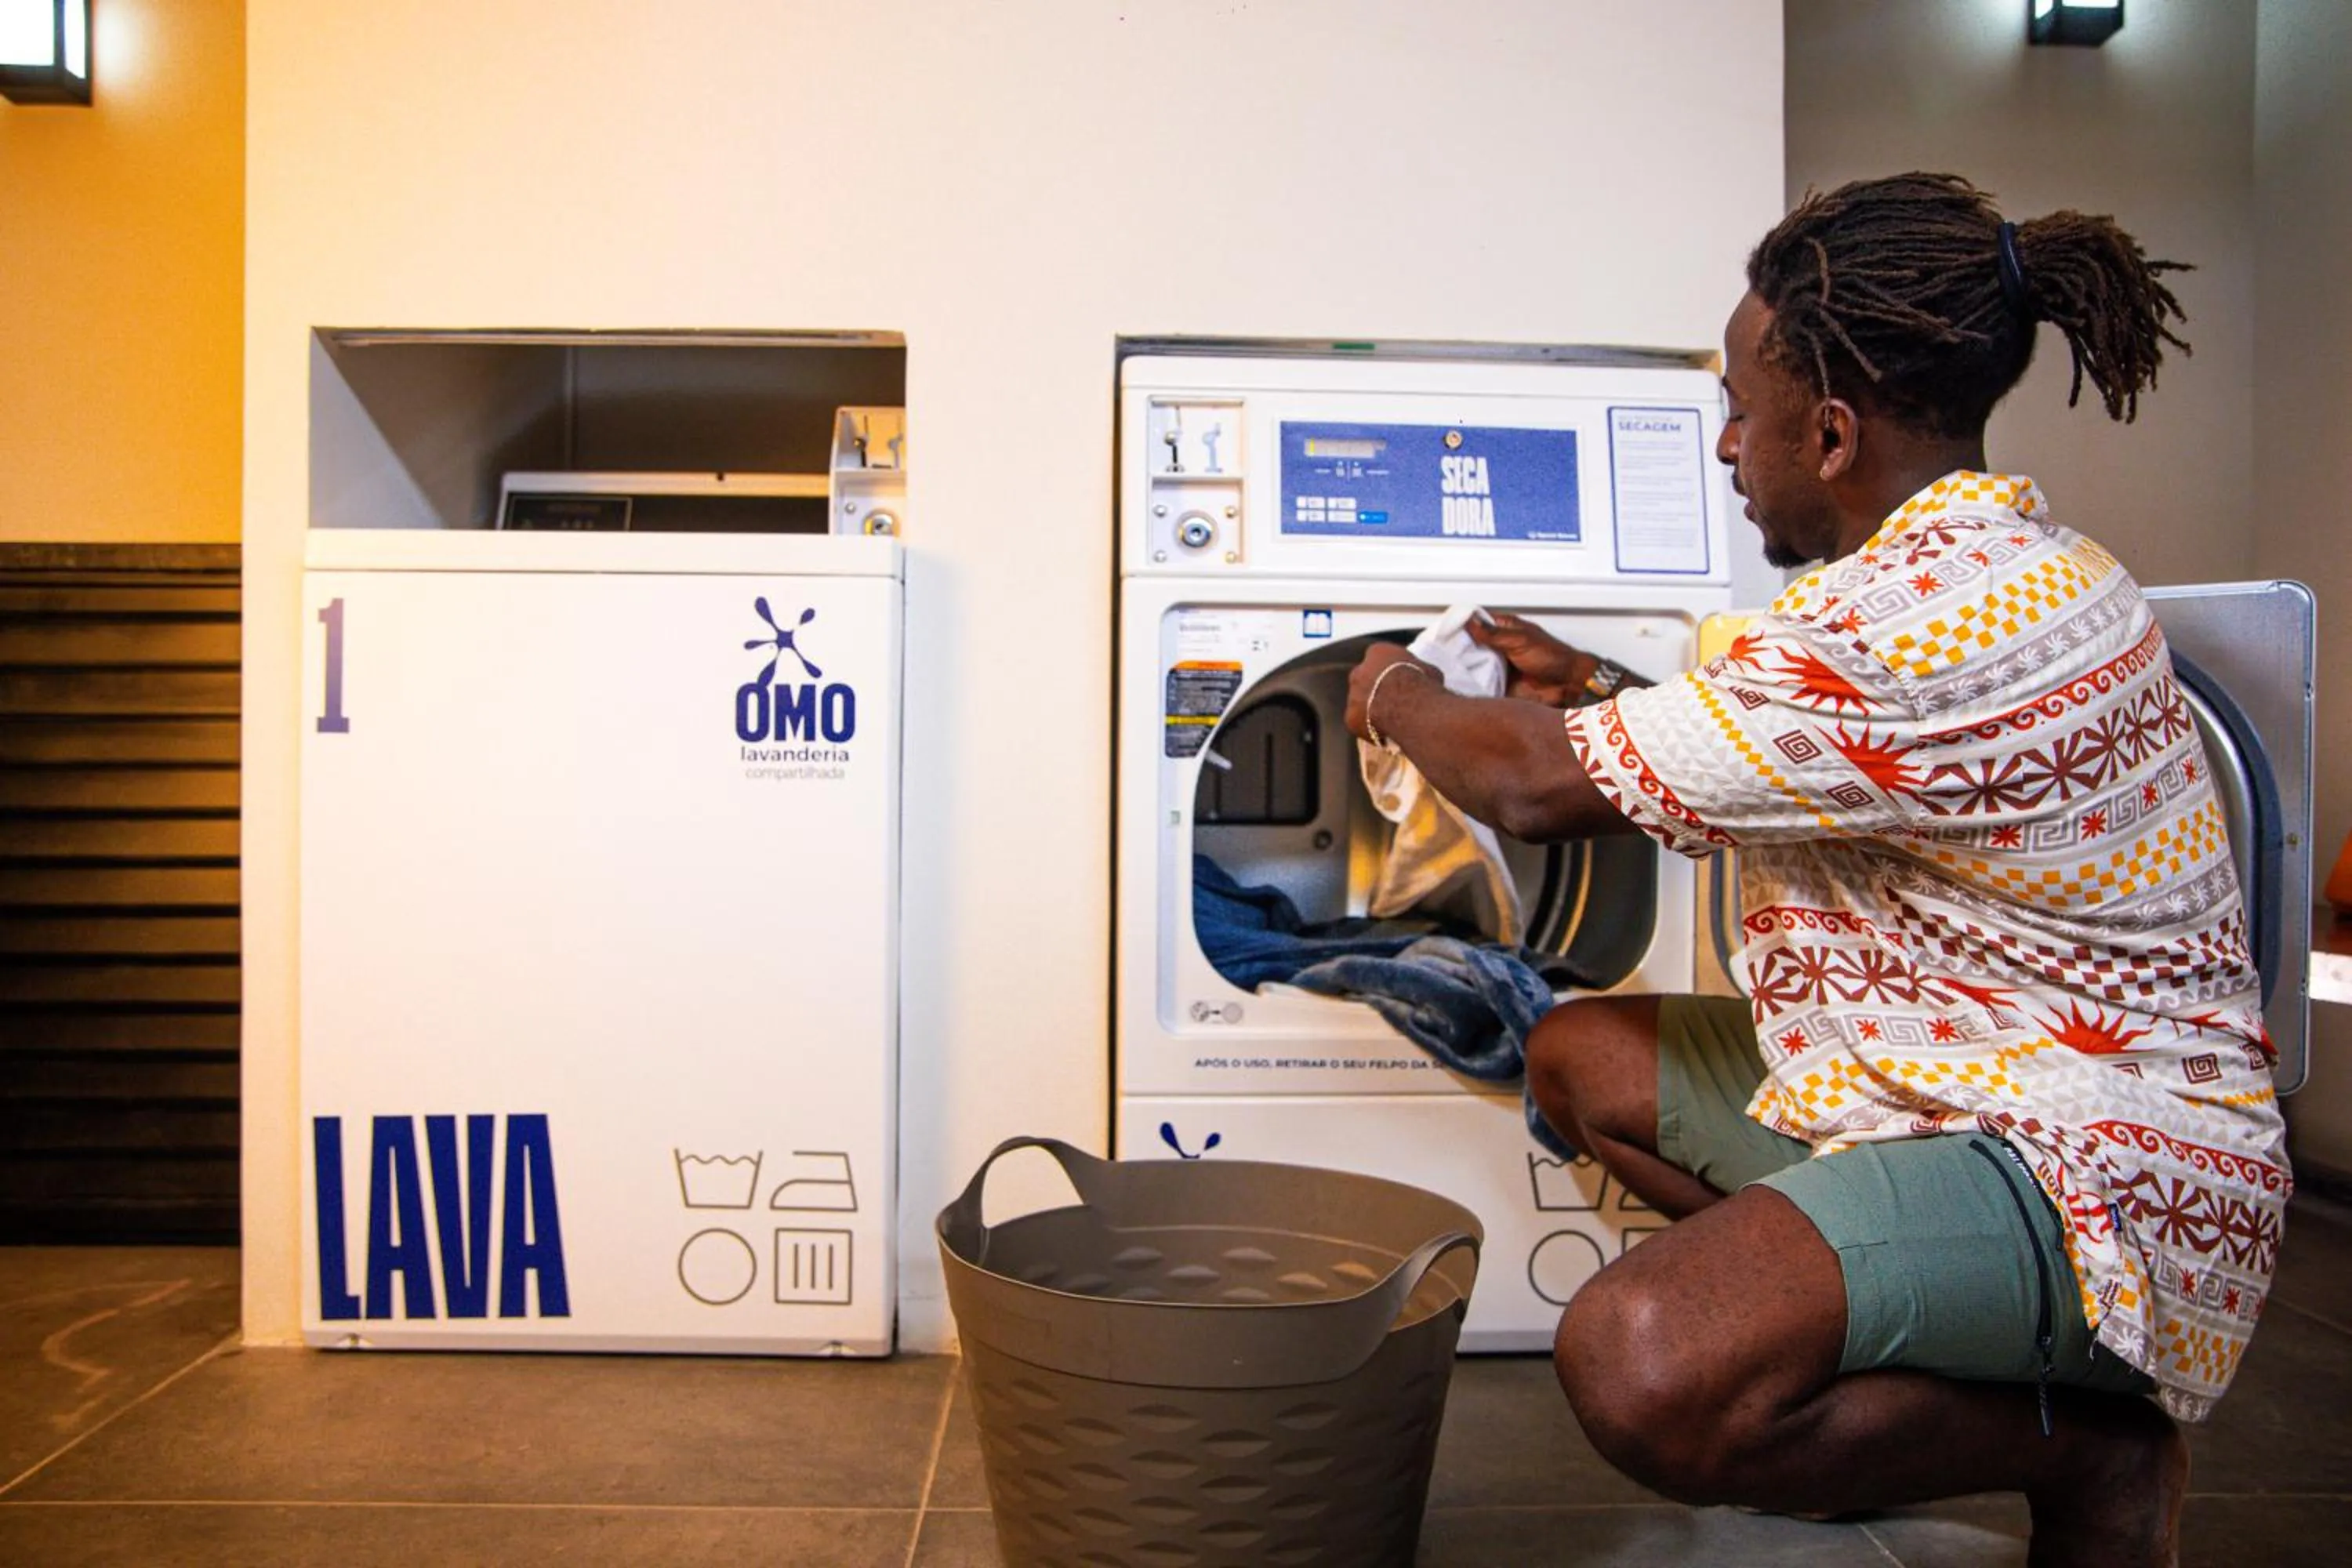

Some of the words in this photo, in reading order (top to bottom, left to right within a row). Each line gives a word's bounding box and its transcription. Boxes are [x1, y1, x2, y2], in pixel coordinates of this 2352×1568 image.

[1618, 421, 1681, 433] SECAGEM
[1441, 456, 1490, 495] SECA
[316, 597, 350, 734] 1
[735, 683, 856, 743] OMO
[740, 746, 850, 762] lavanderia
[745, 766, 845, 781] compartilhada
[1195, 1056, 1228, 1068] APÓS
[1231, 1058, 1241, 1068] O
[1276, 1058, 1327, 1068] RETIRAR
[1330, 1058, 1340, 1069] O
[1343, 1058, 1366, 1069] SEU
[1369, 1058, 1408, 1069] FELPO
[1411, 1058, 1428, 1069] DA
[313, 1113, 571, 1320] LAVA
